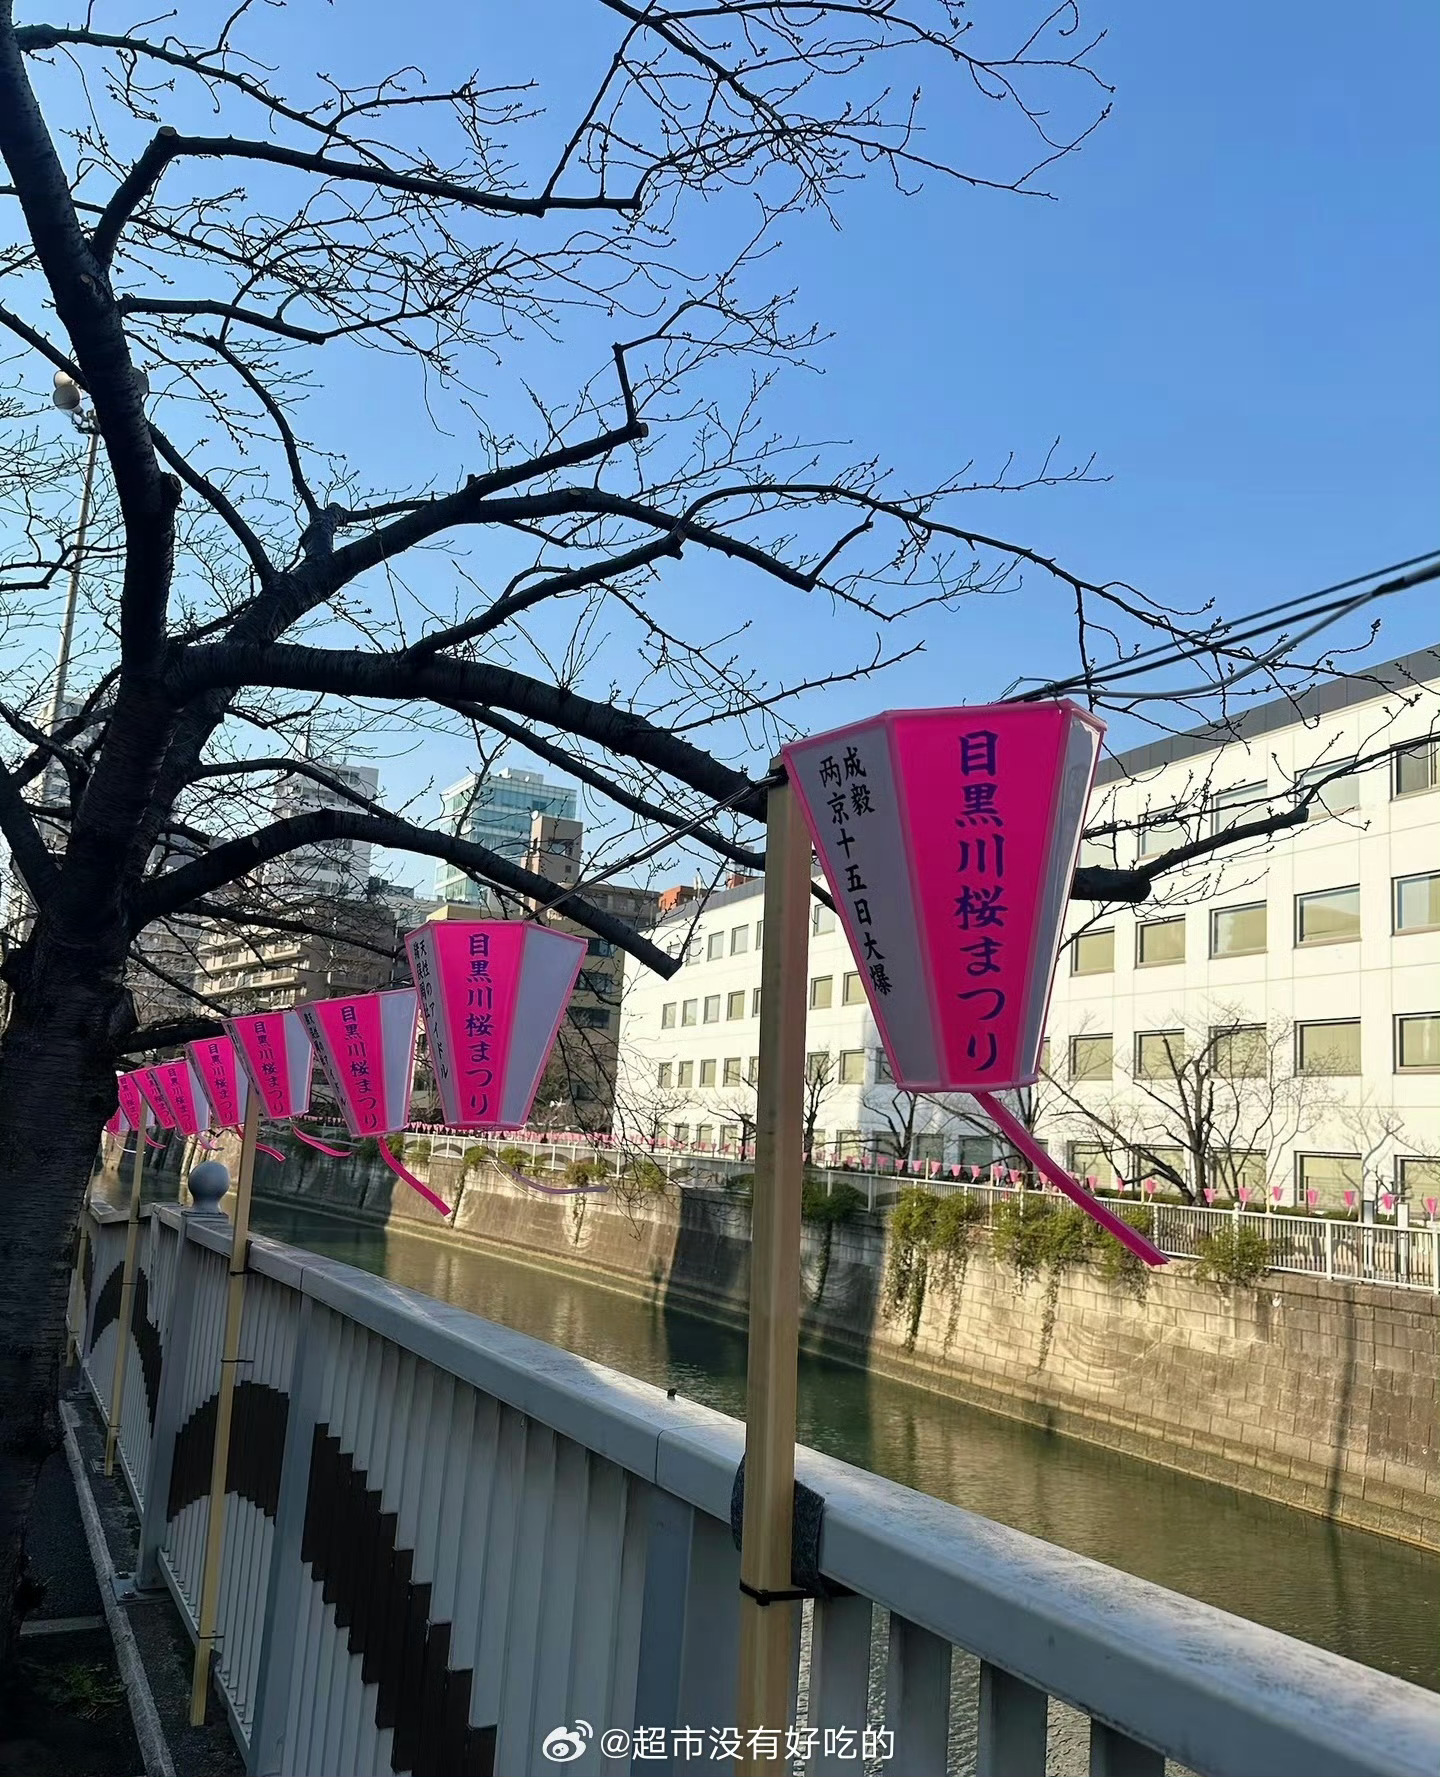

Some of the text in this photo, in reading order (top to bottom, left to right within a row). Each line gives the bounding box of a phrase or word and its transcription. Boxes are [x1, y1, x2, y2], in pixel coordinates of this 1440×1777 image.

[842, 746, 875, 817] 成毅
[819, 755, 893, 996] 两京十五日大爆
[953, 729, 1009, 1072] 目黒川桜まつり
[208, 1043, 234, 1123] 目黒川桜まつり
[254, 1021, 284, 1114] 目黒川桜まつり
[340, 1005, 378, 1130] 目黒川桜まつり
[464, 932, 496, 1116] 目黒川桜まつり
